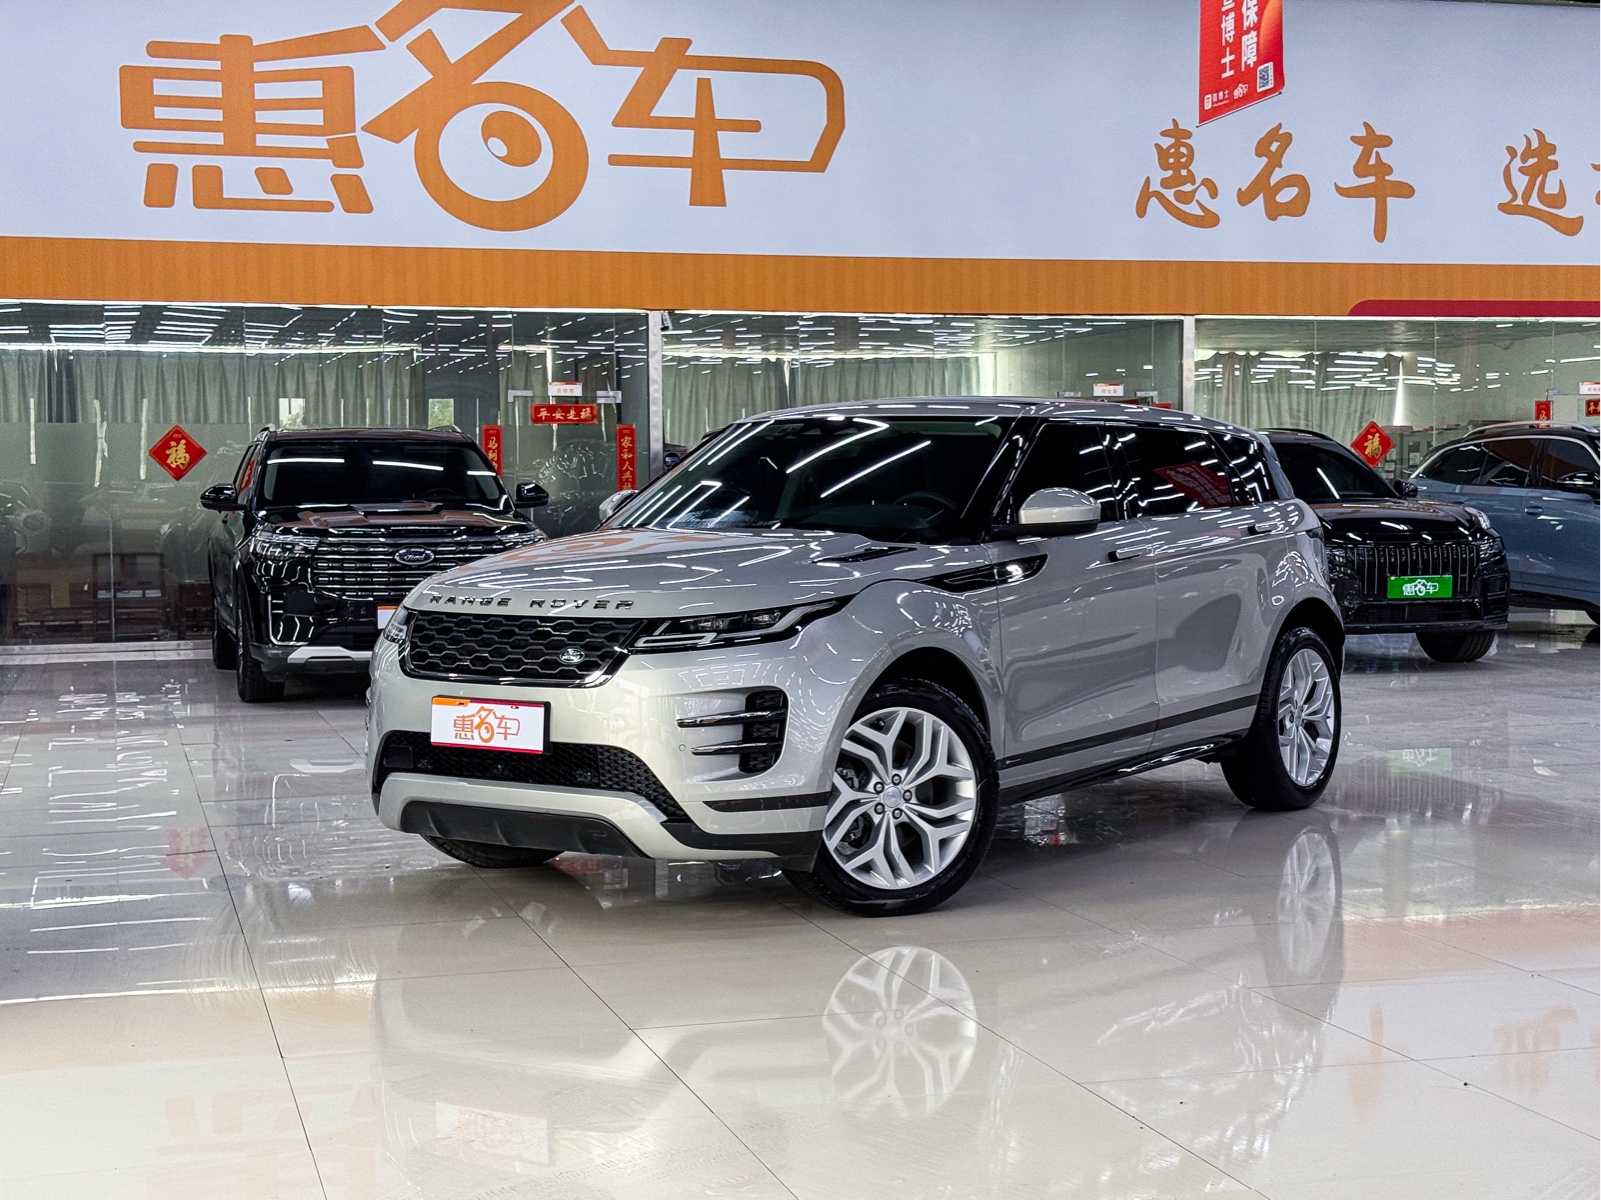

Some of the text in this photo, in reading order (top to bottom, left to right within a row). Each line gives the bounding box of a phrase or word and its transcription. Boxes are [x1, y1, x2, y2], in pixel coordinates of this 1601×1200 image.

[119, 0, 845, 231] 惠名车
[1136, 119, 1600, 243] 惠名车 选
[165, 438, 191, 471] 福
[1363, 432, 1383, 460] 福
[429, 595, 635, 610] RANGE ROVER
[453, 705, 521, 744] 惠名车
